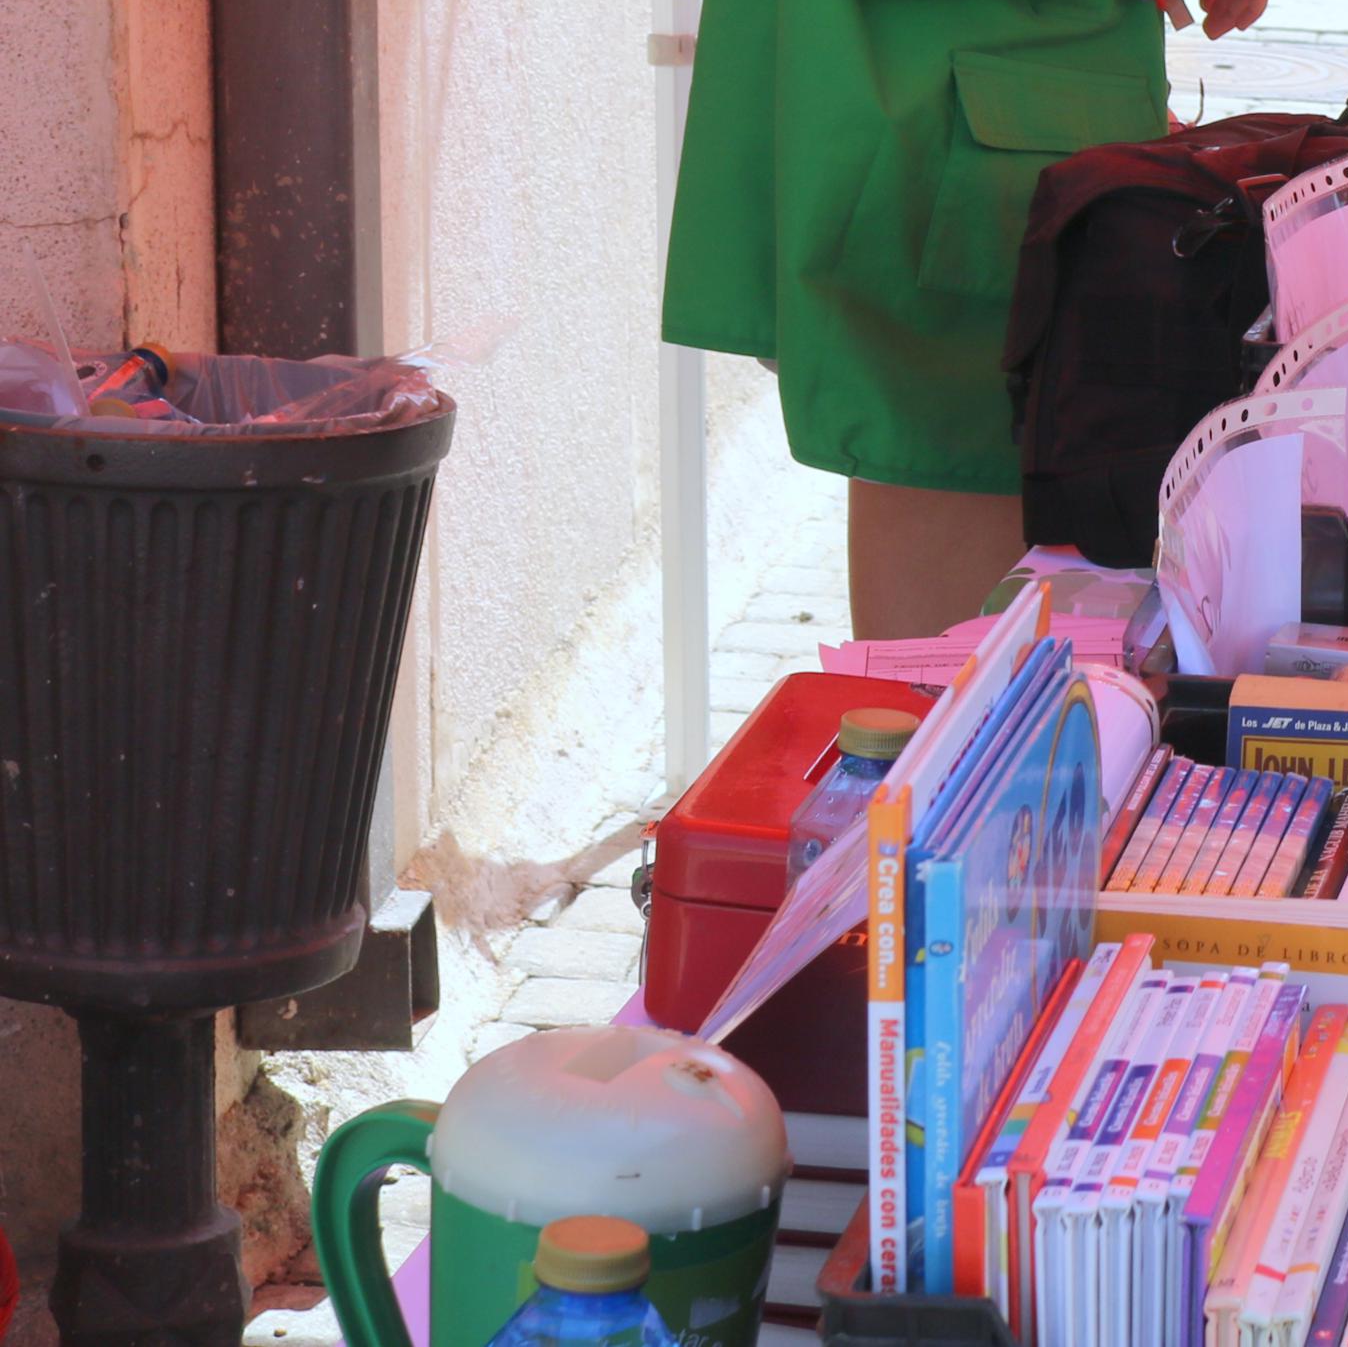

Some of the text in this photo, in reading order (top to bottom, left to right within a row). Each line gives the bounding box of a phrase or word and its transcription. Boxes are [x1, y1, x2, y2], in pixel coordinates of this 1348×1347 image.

[1242, 717, 1257, 728] Los
[1261, 717, 1293, 729] JET
[1295, 721, 1305, 730] de
[1307, 721, 1332, 732] Plaza
[1333, 722, 1341, 732] &
[1319, 825, 1345, 862] NAGUIB
[877, 858, 899, 990] Crea con...
[1160, 939, 1224, 956] SOPA
[1237, 942, 1267, 959] DE
[878, 1019, 898, 1181] Manualidades
[880, 1185, 897, 1229] con
